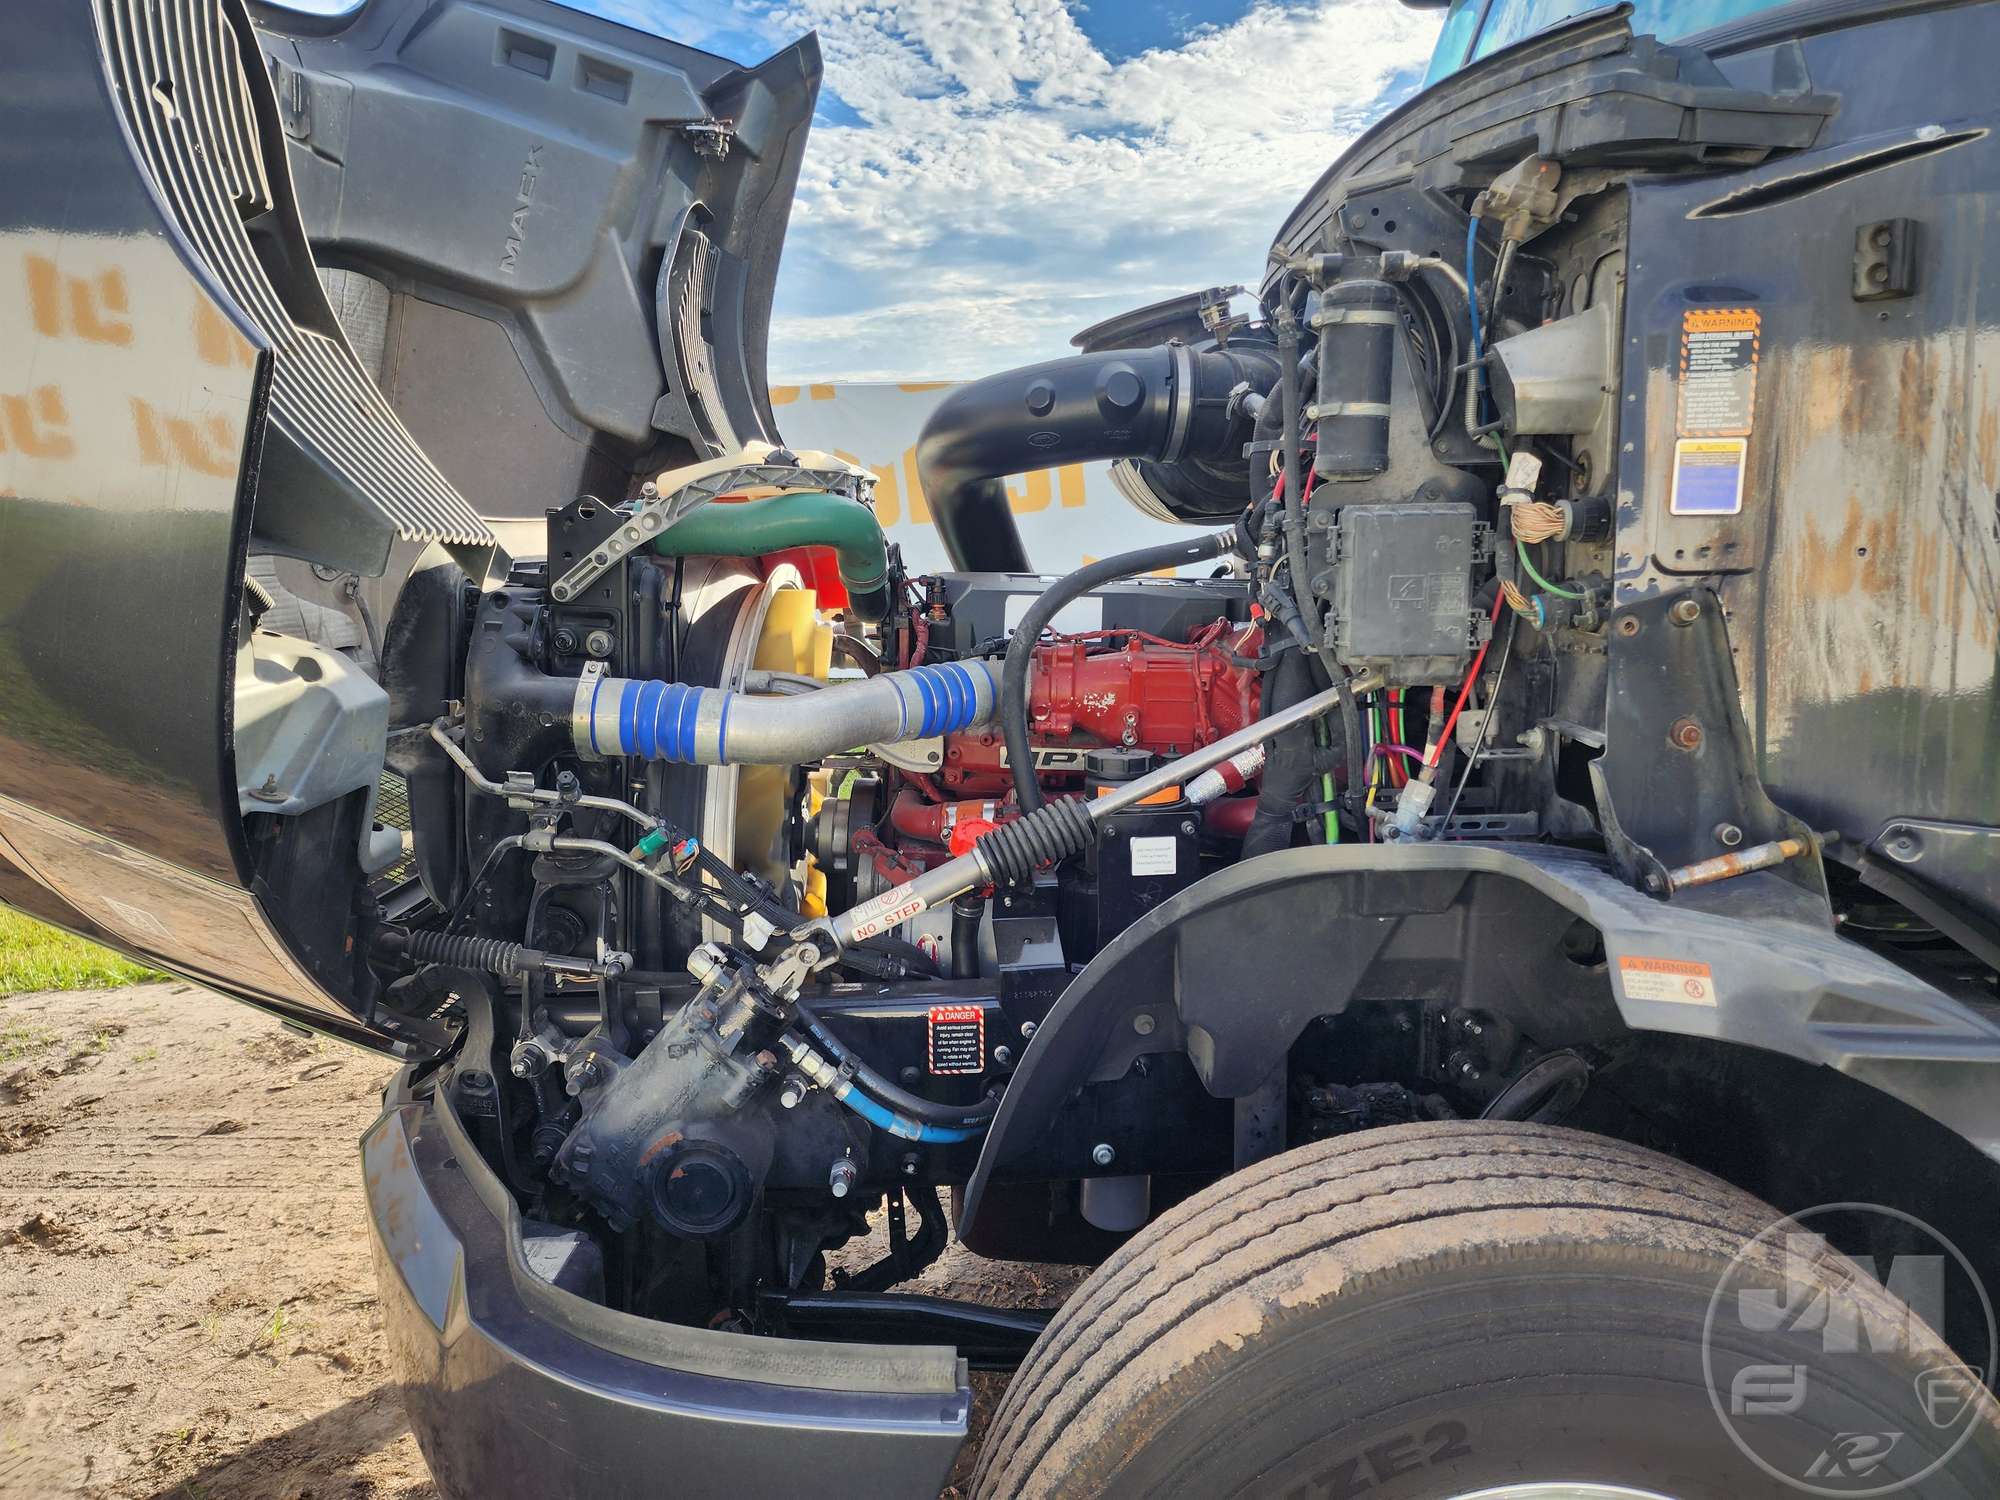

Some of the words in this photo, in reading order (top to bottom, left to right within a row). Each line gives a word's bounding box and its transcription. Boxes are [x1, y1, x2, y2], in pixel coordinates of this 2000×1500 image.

[1701, 318, 1754, 327] WARNING
[856, 923, 877, 939] NO
[884, 901, 920, 925] STEP
[1641, 960, 1704, 975] WARNING
[945, 1011, 976, 1020] DANGER
[1285, 1420, 1472, 1500] ZE2
